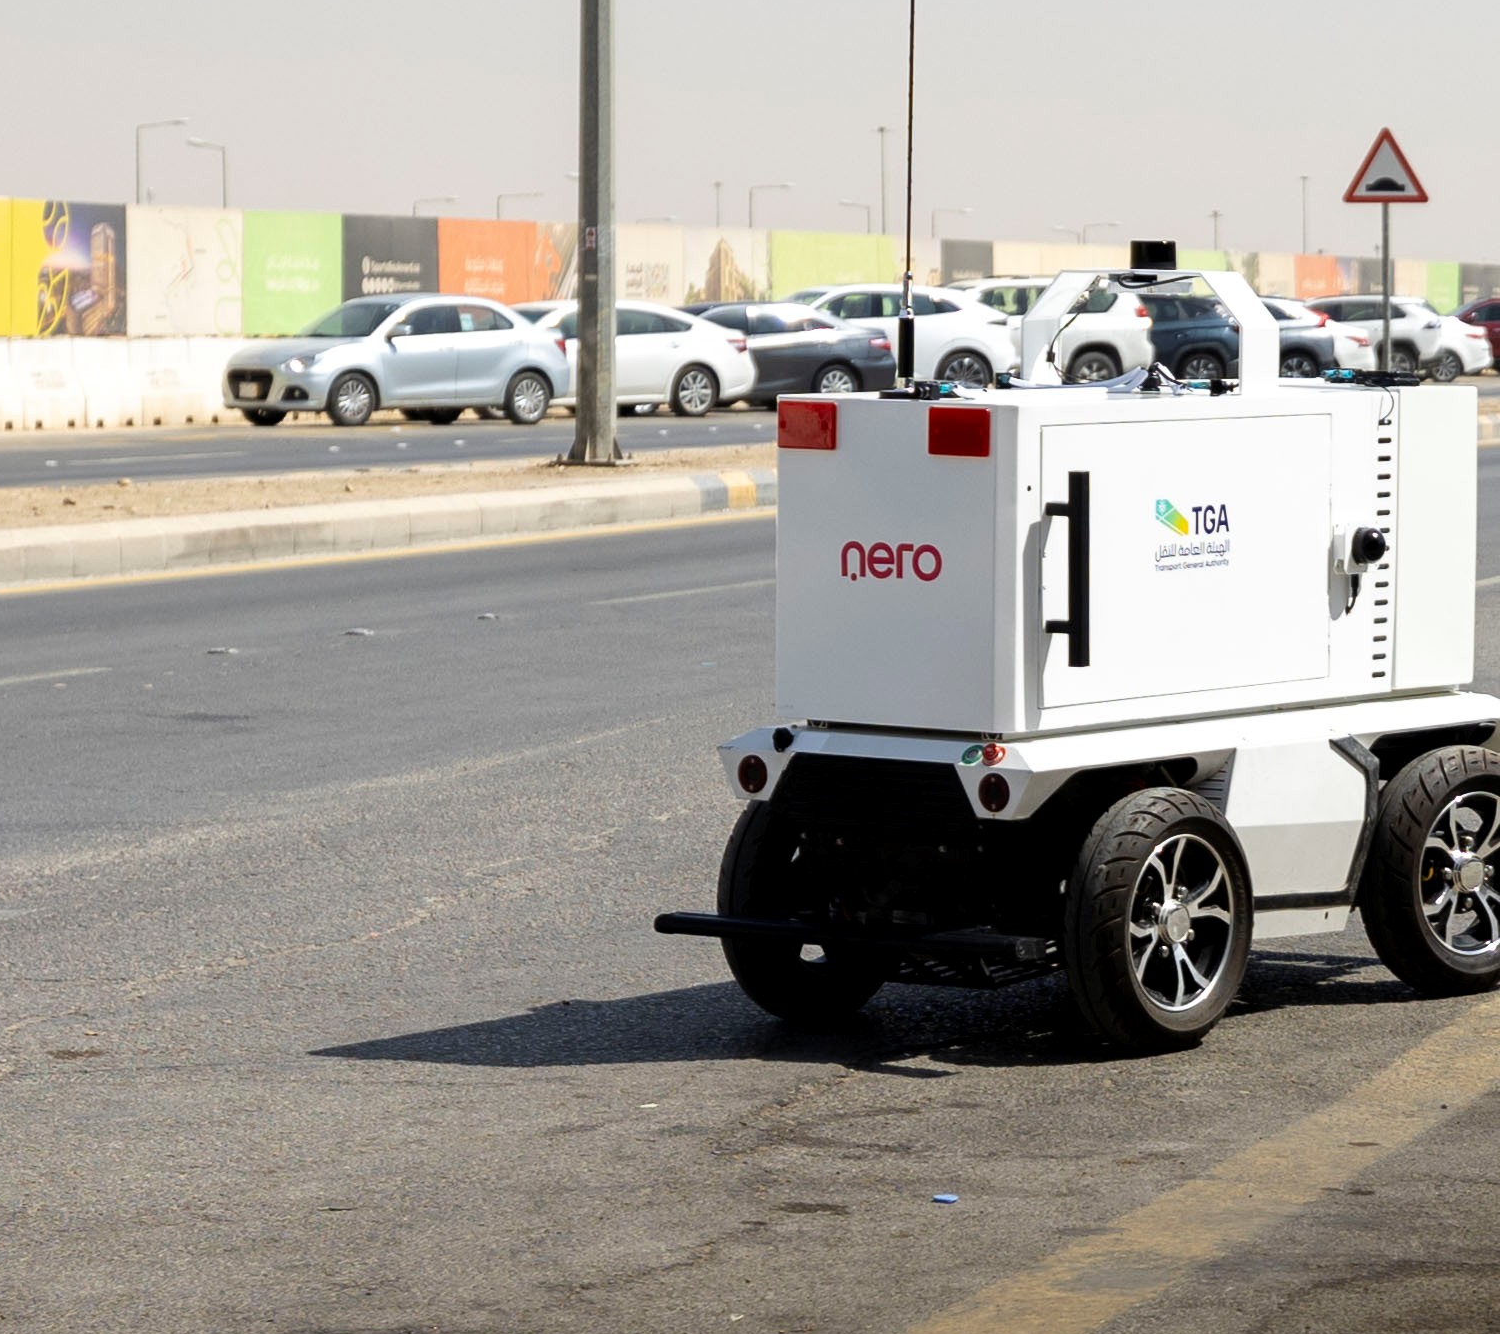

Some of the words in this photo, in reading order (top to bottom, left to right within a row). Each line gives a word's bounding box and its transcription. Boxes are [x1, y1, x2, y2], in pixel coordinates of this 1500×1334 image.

[1191, 504, 1230, 535] TGA
[1155, 543, 1177, 562] للنقل
[1178, 542, 1206, 556] العامة
[1206, 539, 1230, 557] الهيئة
[841, 540, 942, 582] nero
